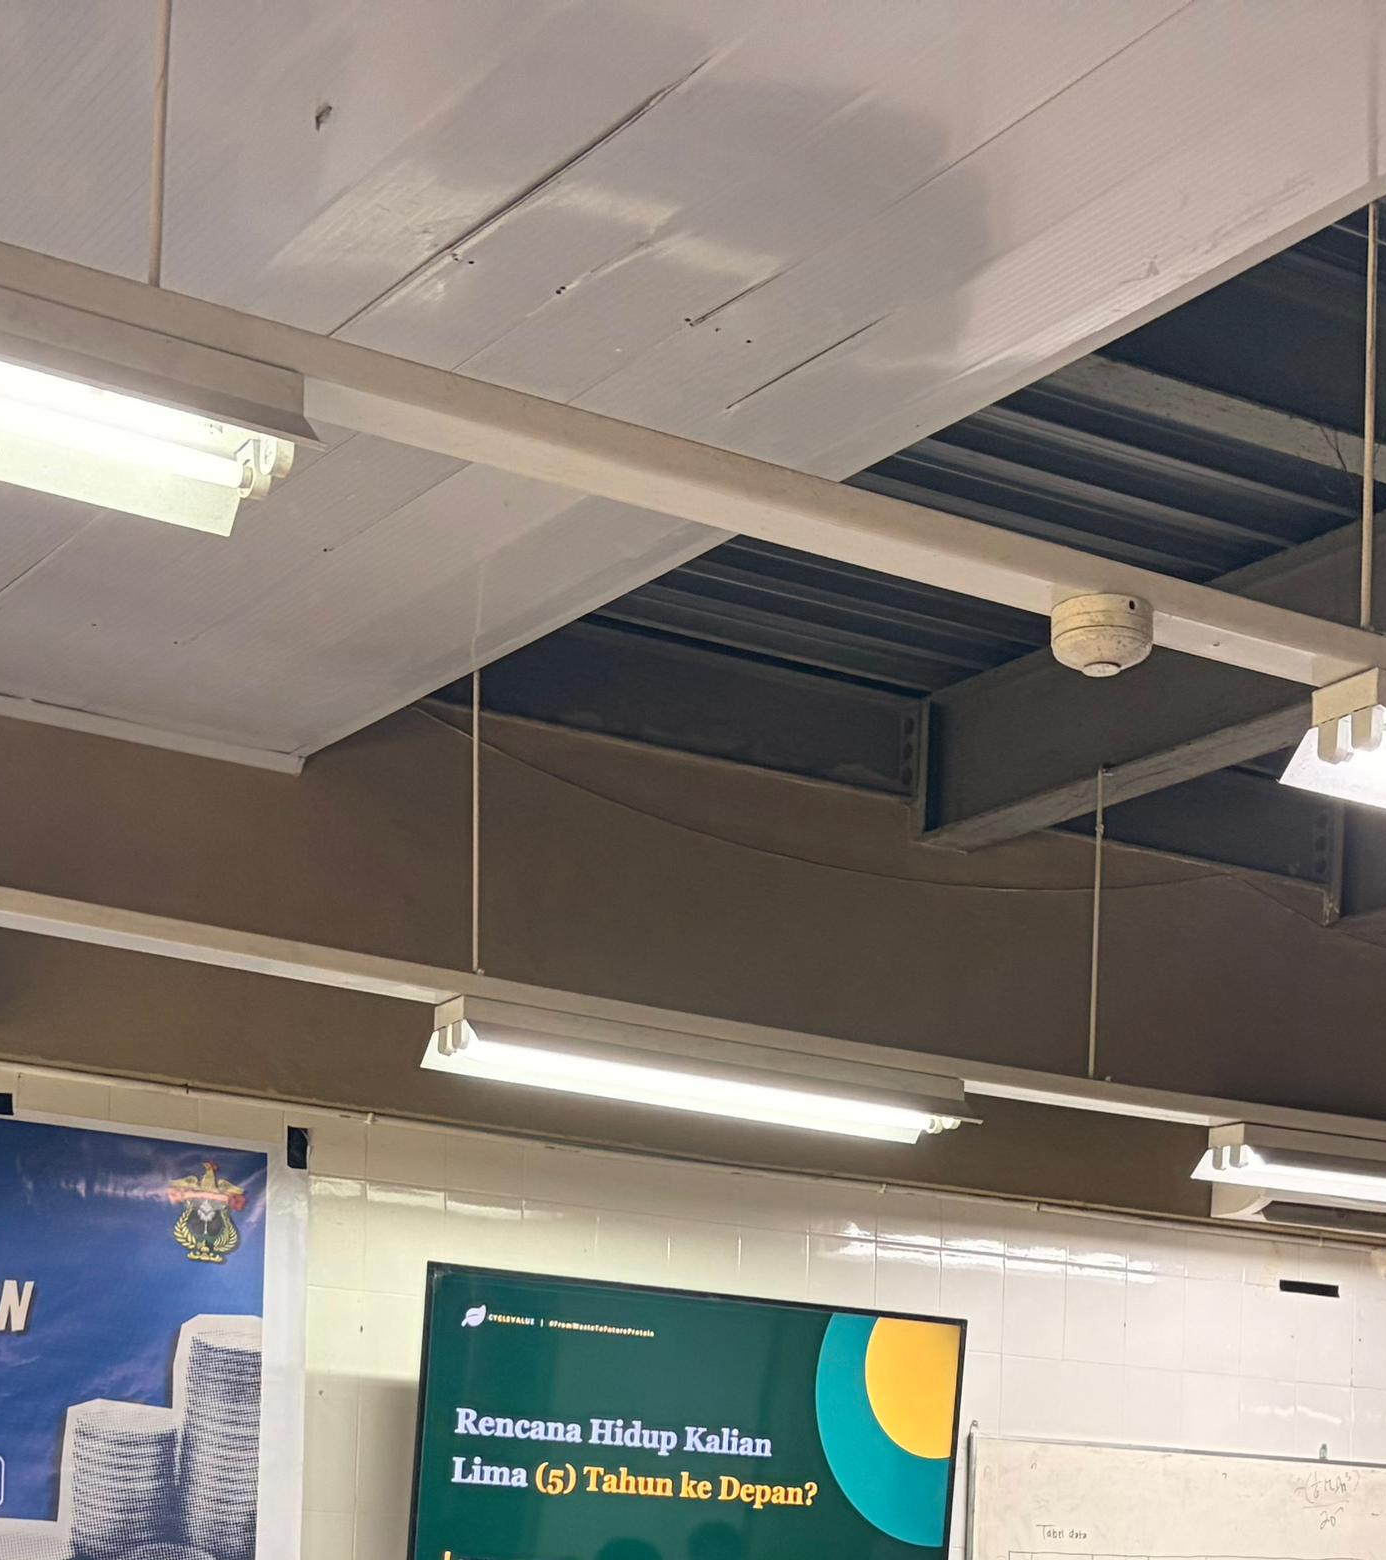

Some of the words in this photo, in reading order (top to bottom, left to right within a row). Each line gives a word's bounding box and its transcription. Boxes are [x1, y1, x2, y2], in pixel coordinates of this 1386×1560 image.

[454, 1407, 582, 1443] Rencana
[589, 1418, 678, 1456] Hidup
[683, 1425, 773, 1458] Kalian
[451, 1456, 528, 1488] Lima
[535, 1461, 577, 1495] (5)
[583, 1465, 674, 1498] Tahun
[680, 1472, 712, 1500] ke
[718, 1476, 819, 1509] Depan?
[1068, 1528, 1087, 1540] data
